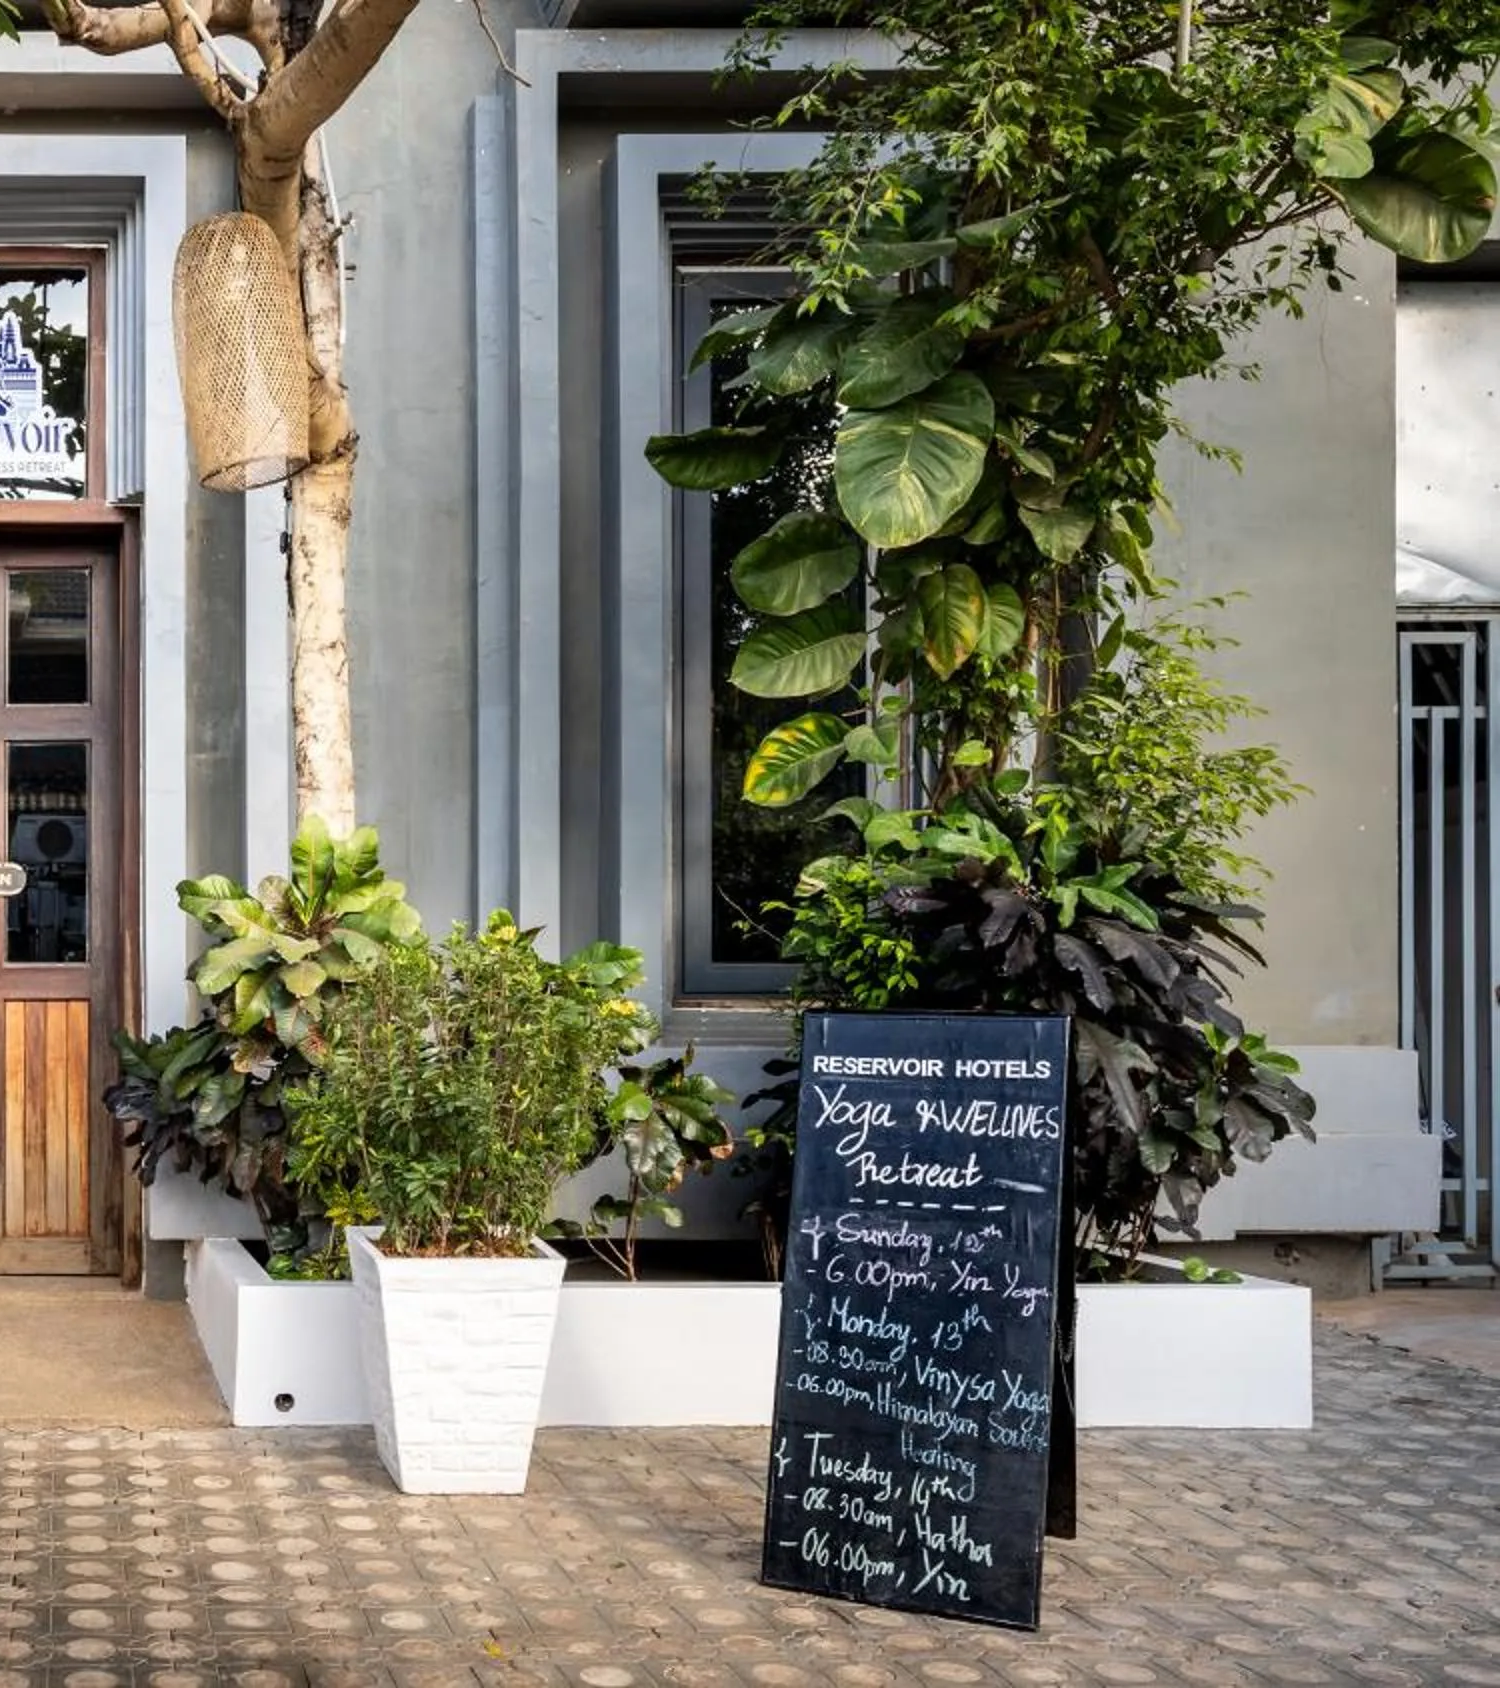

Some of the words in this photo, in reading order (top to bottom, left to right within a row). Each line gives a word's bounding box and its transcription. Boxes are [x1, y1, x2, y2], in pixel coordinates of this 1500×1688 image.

[18, 461, 67, 473] RETREAT
[813, 1055, 944, 1078] RESERVOIR
[955, 1059, 1051, 1079] HOTELS
[813, 1083, 897, 1156] Yoga
[845, 1151, 983, 1188] Retreat
[911, 1547, 971, 1601] Yin
